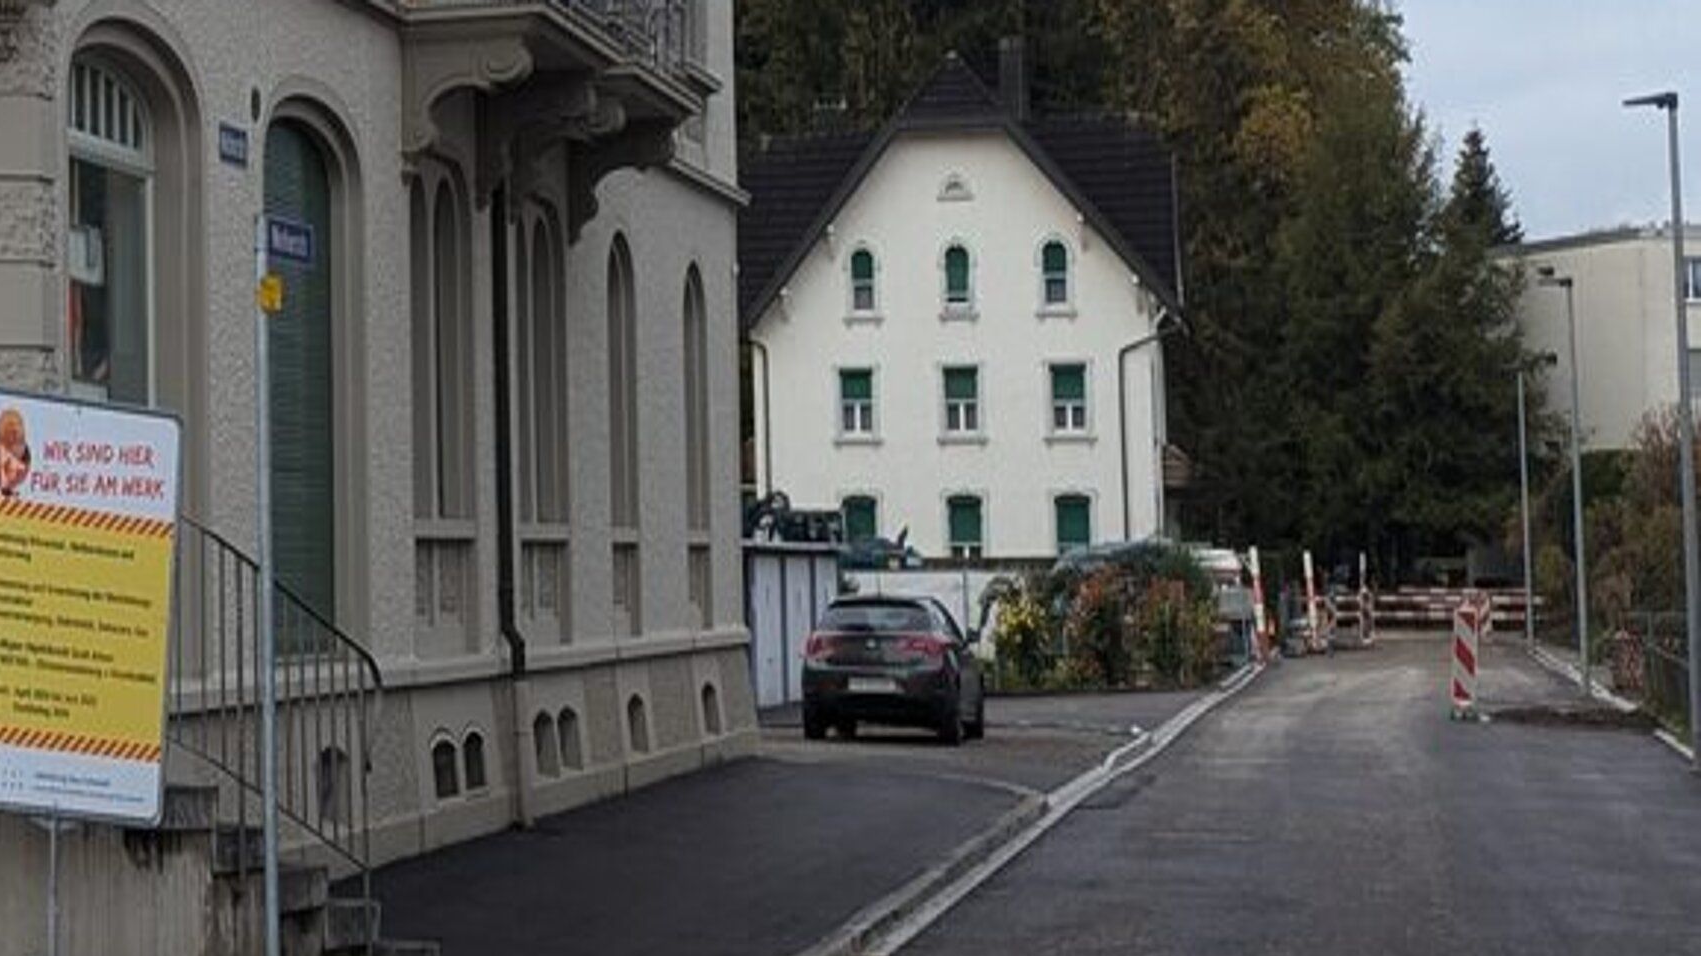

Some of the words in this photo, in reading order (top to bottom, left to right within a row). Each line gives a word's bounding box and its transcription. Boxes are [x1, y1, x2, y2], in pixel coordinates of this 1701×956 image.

[42, 440, 72, 465] WIR
[77, 442, 114, 464] SIND
[118, 445, 156, 468] HIER
[30, 470, 61, 496] FÜR
[65, 472, 89, 494] SIE
[93, 474, 117, 497] AM
[121, 476, 165, 500] WERK
